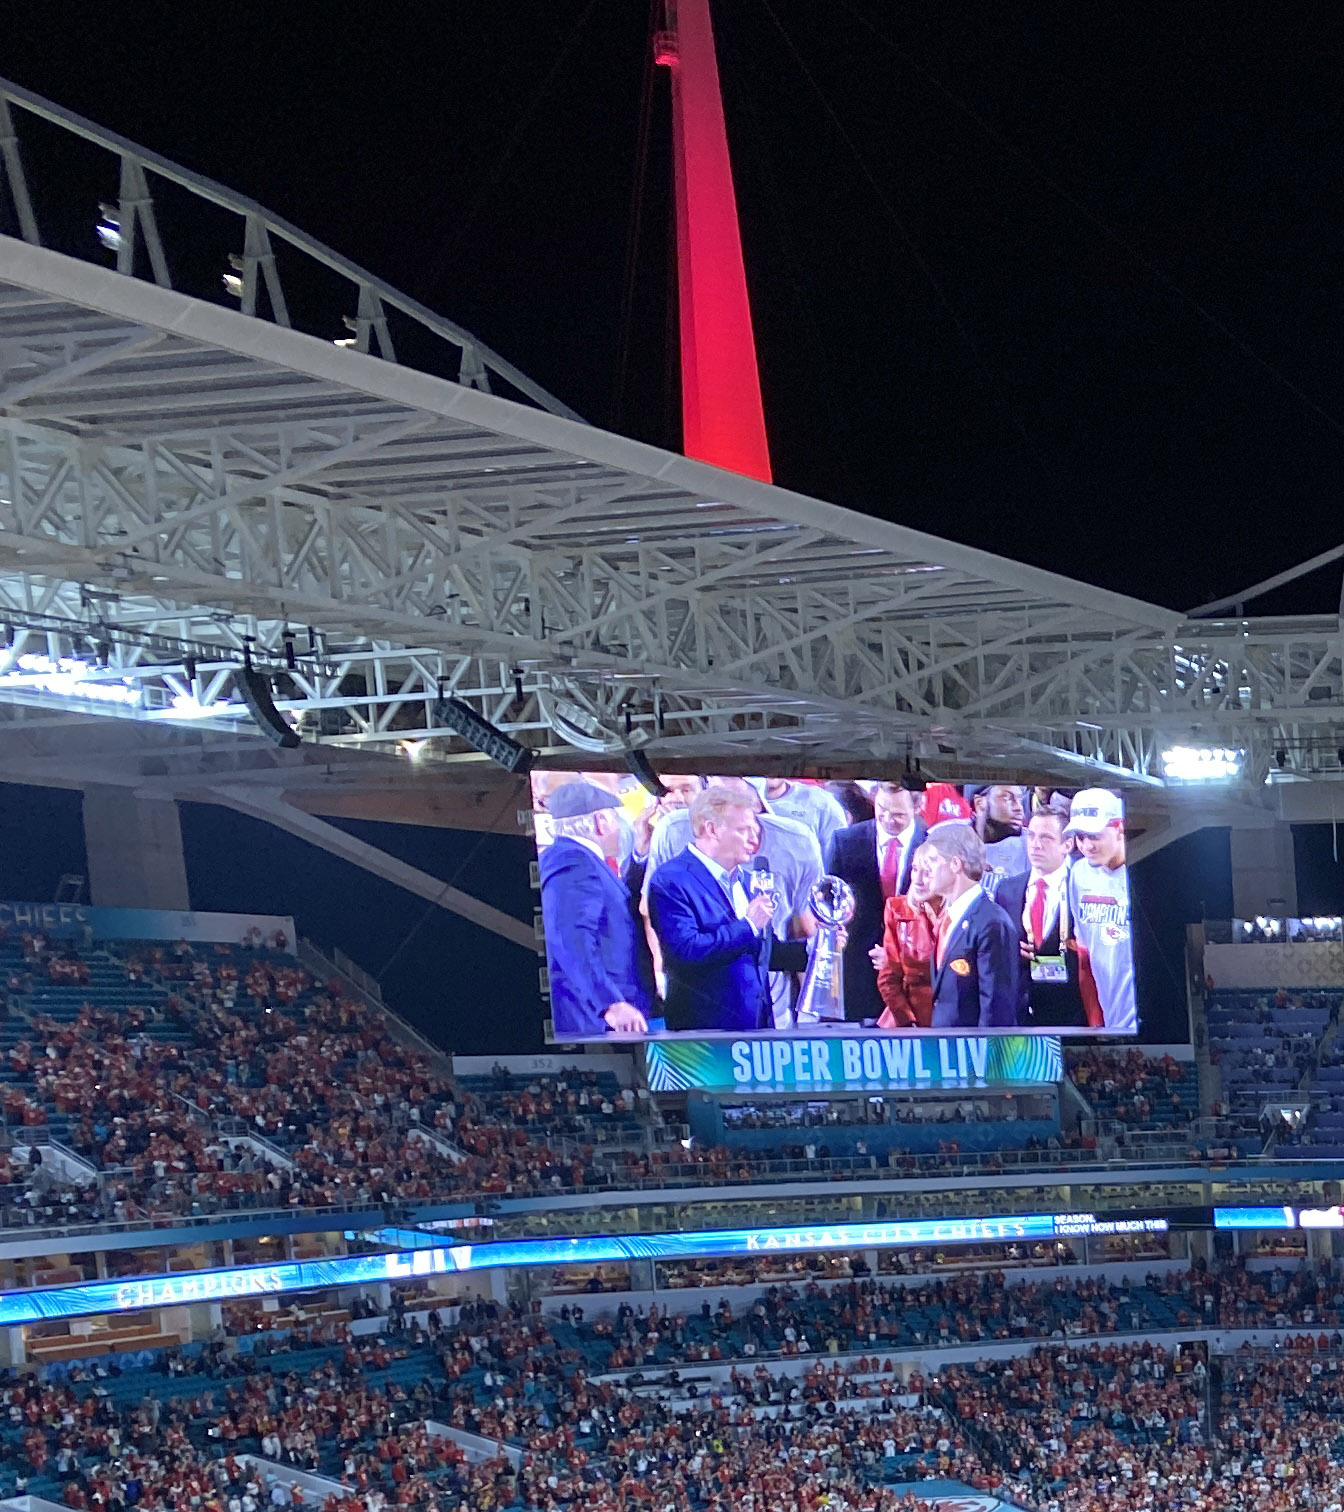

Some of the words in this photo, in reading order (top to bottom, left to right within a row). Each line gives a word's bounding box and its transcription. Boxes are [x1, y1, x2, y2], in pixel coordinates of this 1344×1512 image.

[732, 1040, 832, 1082] SUPER
[842, 1038, 931, 1081] BOWL
[938, 1037, 988, 1079] LIV
[746, 1229, 851, 1252] KANSAS
[862, 1226, 922, 1243] CITY
[933, 1222, 1026, 1239] CHIEFS
[1060, 1223, 1090, 1233] KNOW
[1091, 1222, 1115, 1232] HOW
[1115, 1220, 1144, 1231] MUCH
[117, 1269, 282, 1308] CHAMPIONS
